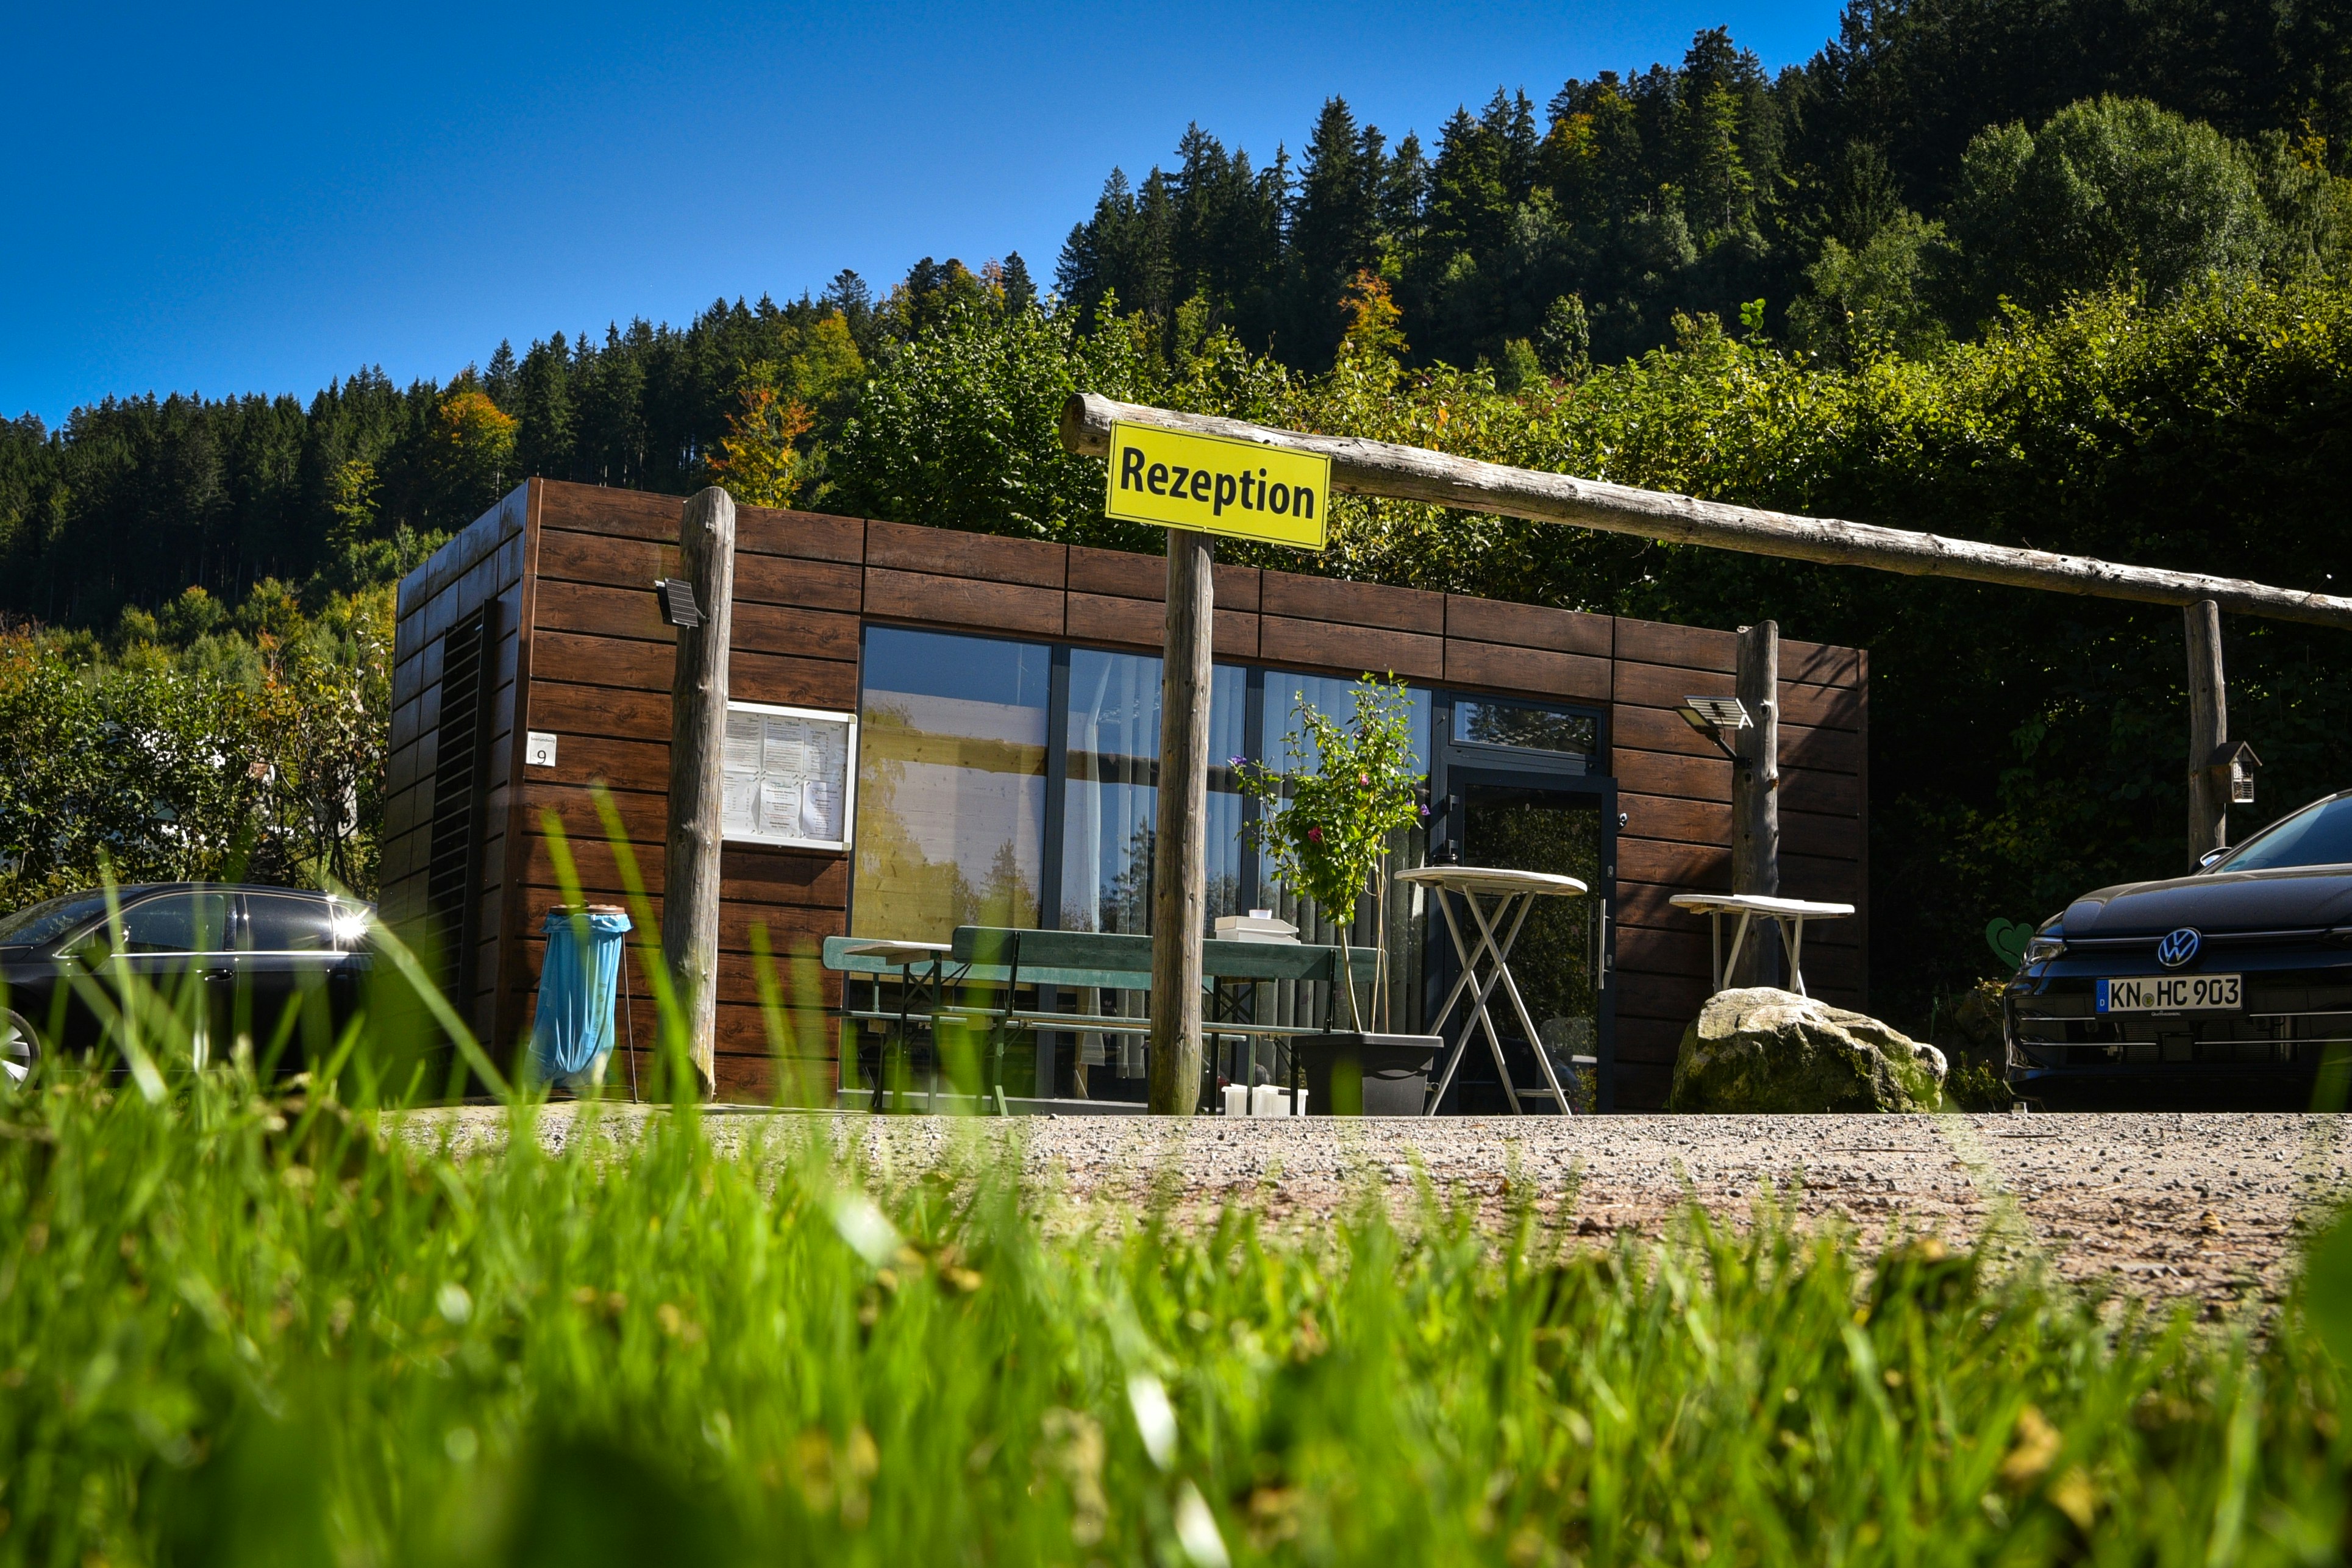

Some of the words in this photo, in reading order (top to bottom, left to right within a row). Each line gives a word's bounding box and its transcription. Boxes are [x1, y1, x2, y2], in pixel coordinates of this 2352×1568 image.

[1121, 446, 1314, 519] Rezeption
[537, 750, 546, 764] 9
[2160, 929, 2198, 965] VW
[2111, 982, 2140, 1008] KN
[2157, 980, 2187, 1006] HC
[2193, 978, 2239, 1005] 903
